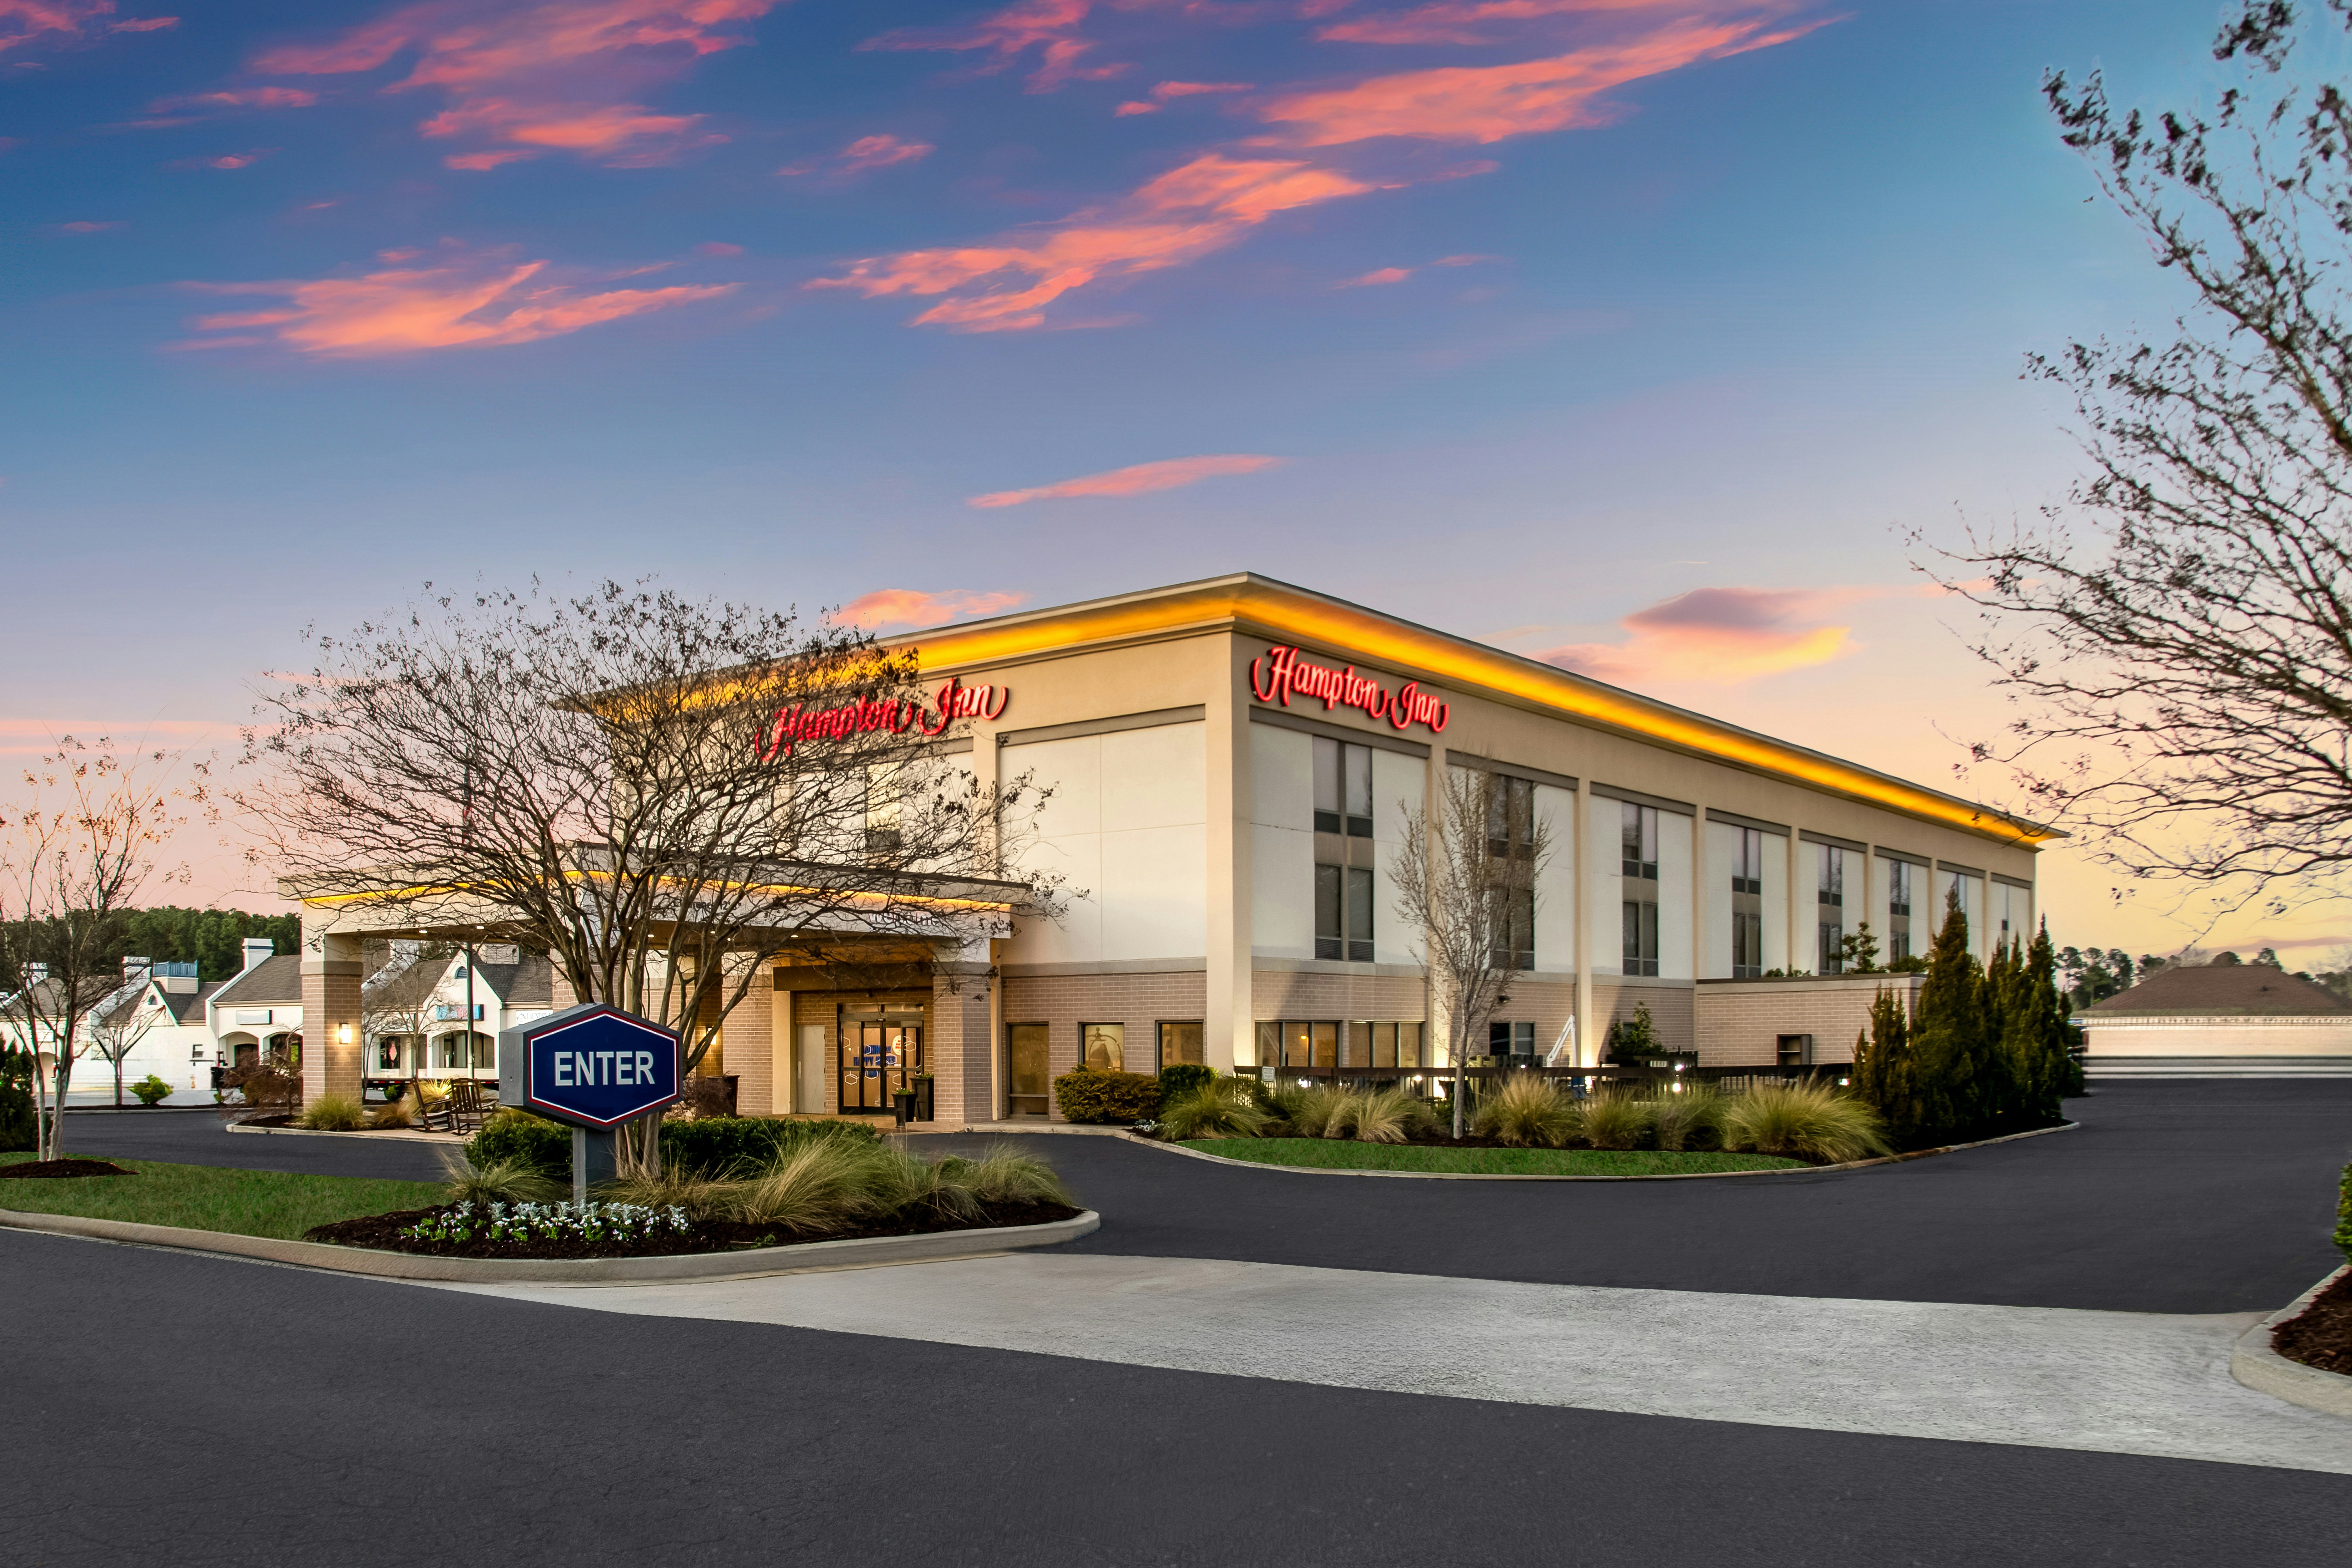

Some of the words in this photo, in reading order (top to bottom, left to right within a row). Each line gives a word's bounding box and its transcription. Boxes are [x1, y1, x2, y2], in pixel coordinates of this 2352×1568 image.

[755, 695, 912, 761] Hampton
[918, 677, 1006, 736] Inn
[1254, 646, 1388, 718] Hampton
[1391, 681, 1449, 732] Inn
[555, 1051, 655, 1086] ENTER
